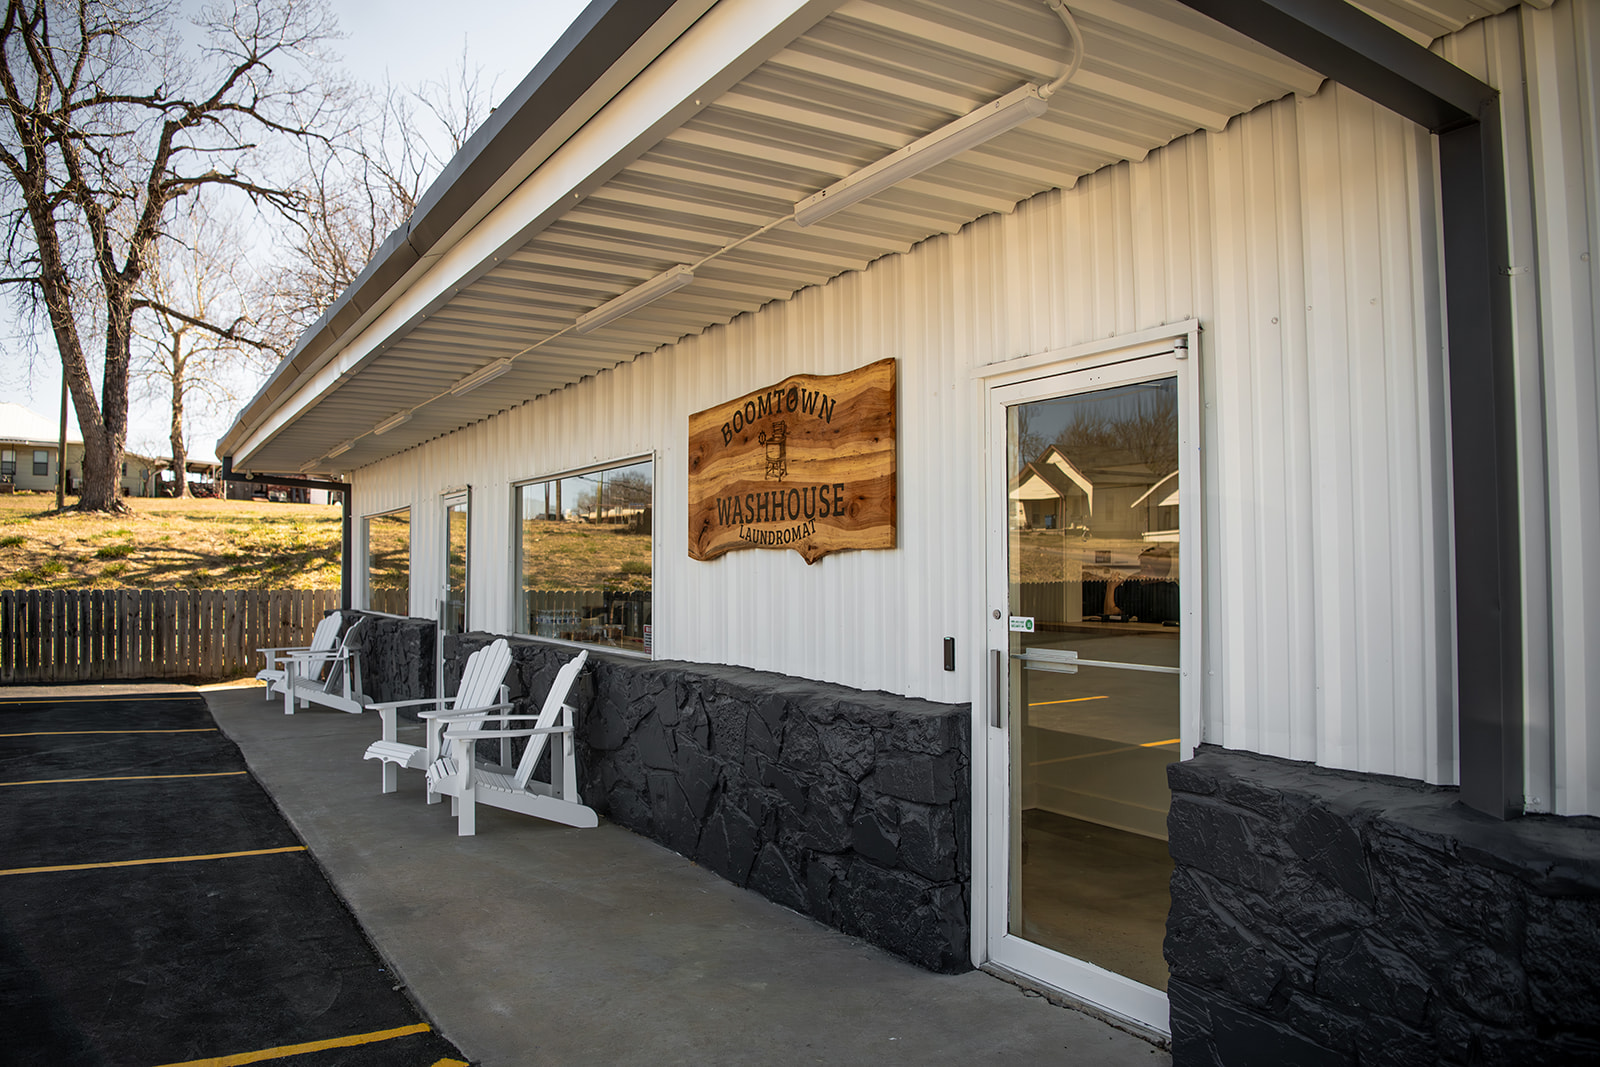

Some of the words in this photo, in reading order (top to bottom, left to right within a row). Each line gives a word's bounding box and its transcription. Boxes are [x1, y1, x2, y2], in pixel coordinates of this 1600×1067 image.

[721, 387, 837, 447] BOOMTOWN
[716, 483, 845, 526] WASHHOUSE
[739, 518, 817, 545] LAUNDROMAT
